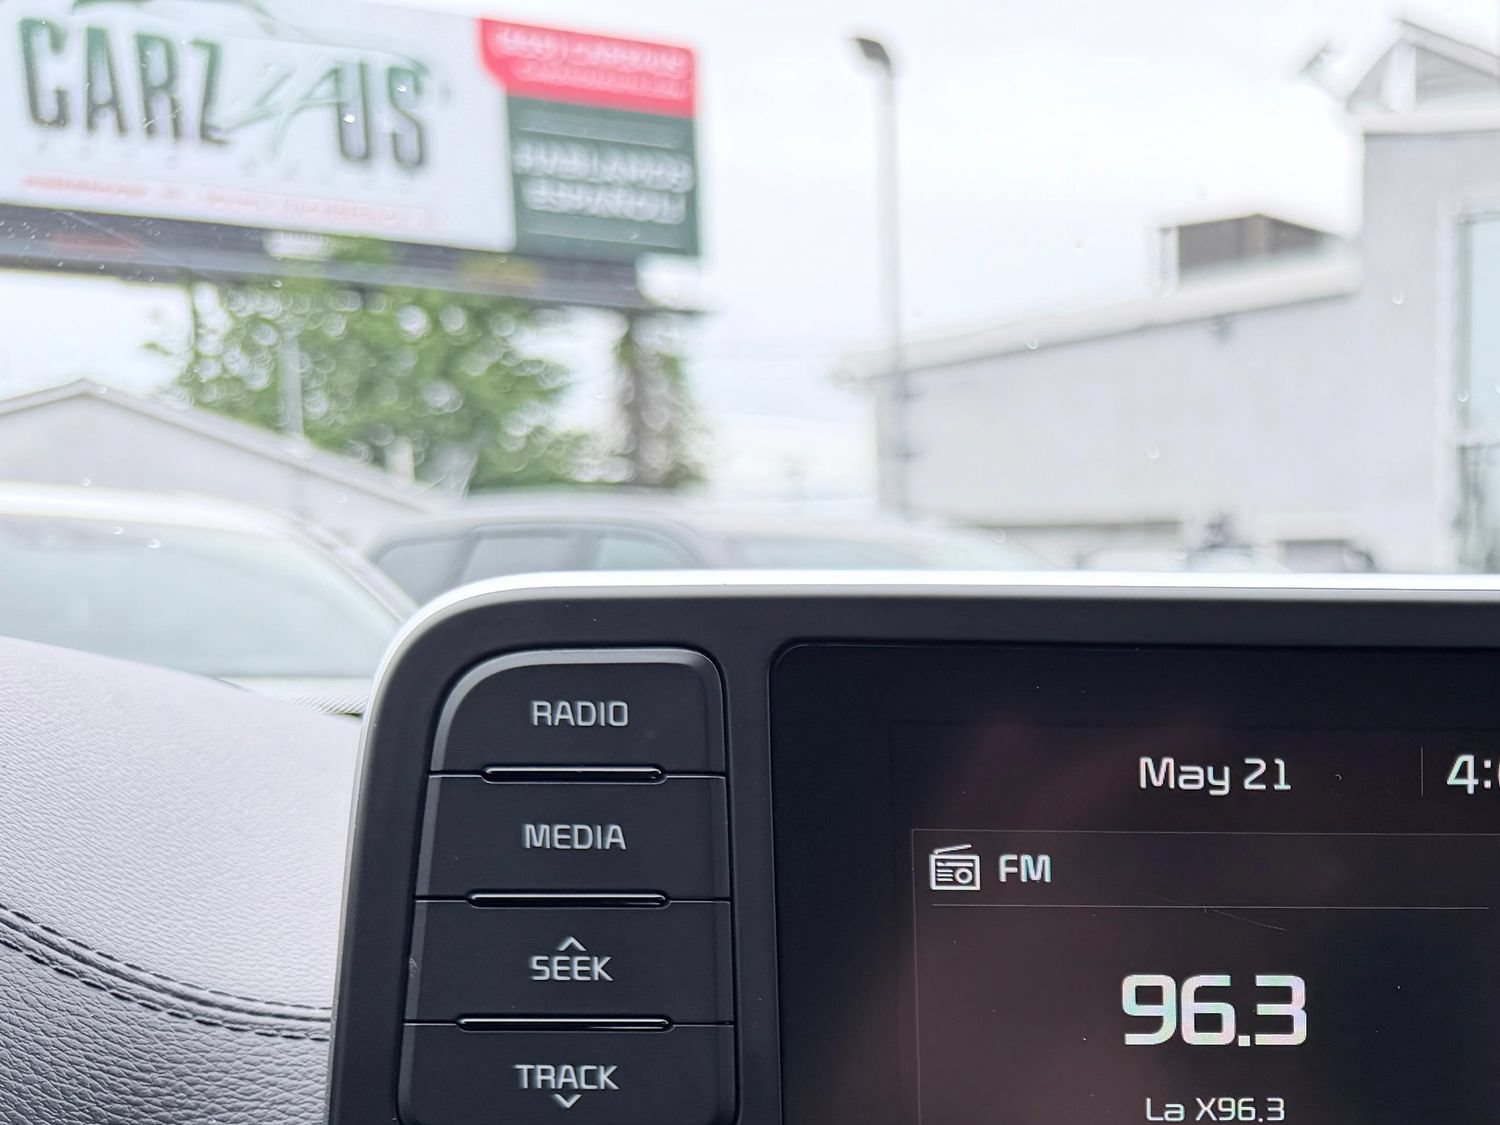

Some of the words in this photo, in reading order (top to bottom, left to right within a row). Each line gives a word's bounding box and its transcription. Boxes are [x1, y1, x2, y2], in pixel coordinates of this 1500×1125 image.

[18, 17, 229, 146] CARZ
[336, 60, 428, 170] US
[532, 700, 629, 727] RADIO
[1139, 756, 1230, 796] May
[1243, 757, 1292, 791] 21
[524, 823, 627, 850] MEDIA
[999, 854, 1051, 883] FM
[530, 955, 614, 981] SEEK
[1121, 974, 1307, 1047] 96.3
[514, 1064, 620, 1090] TRACK
[1146, 1097, 1185, 1122] La
[1195, 1097, 1285, 1123] X96.3
